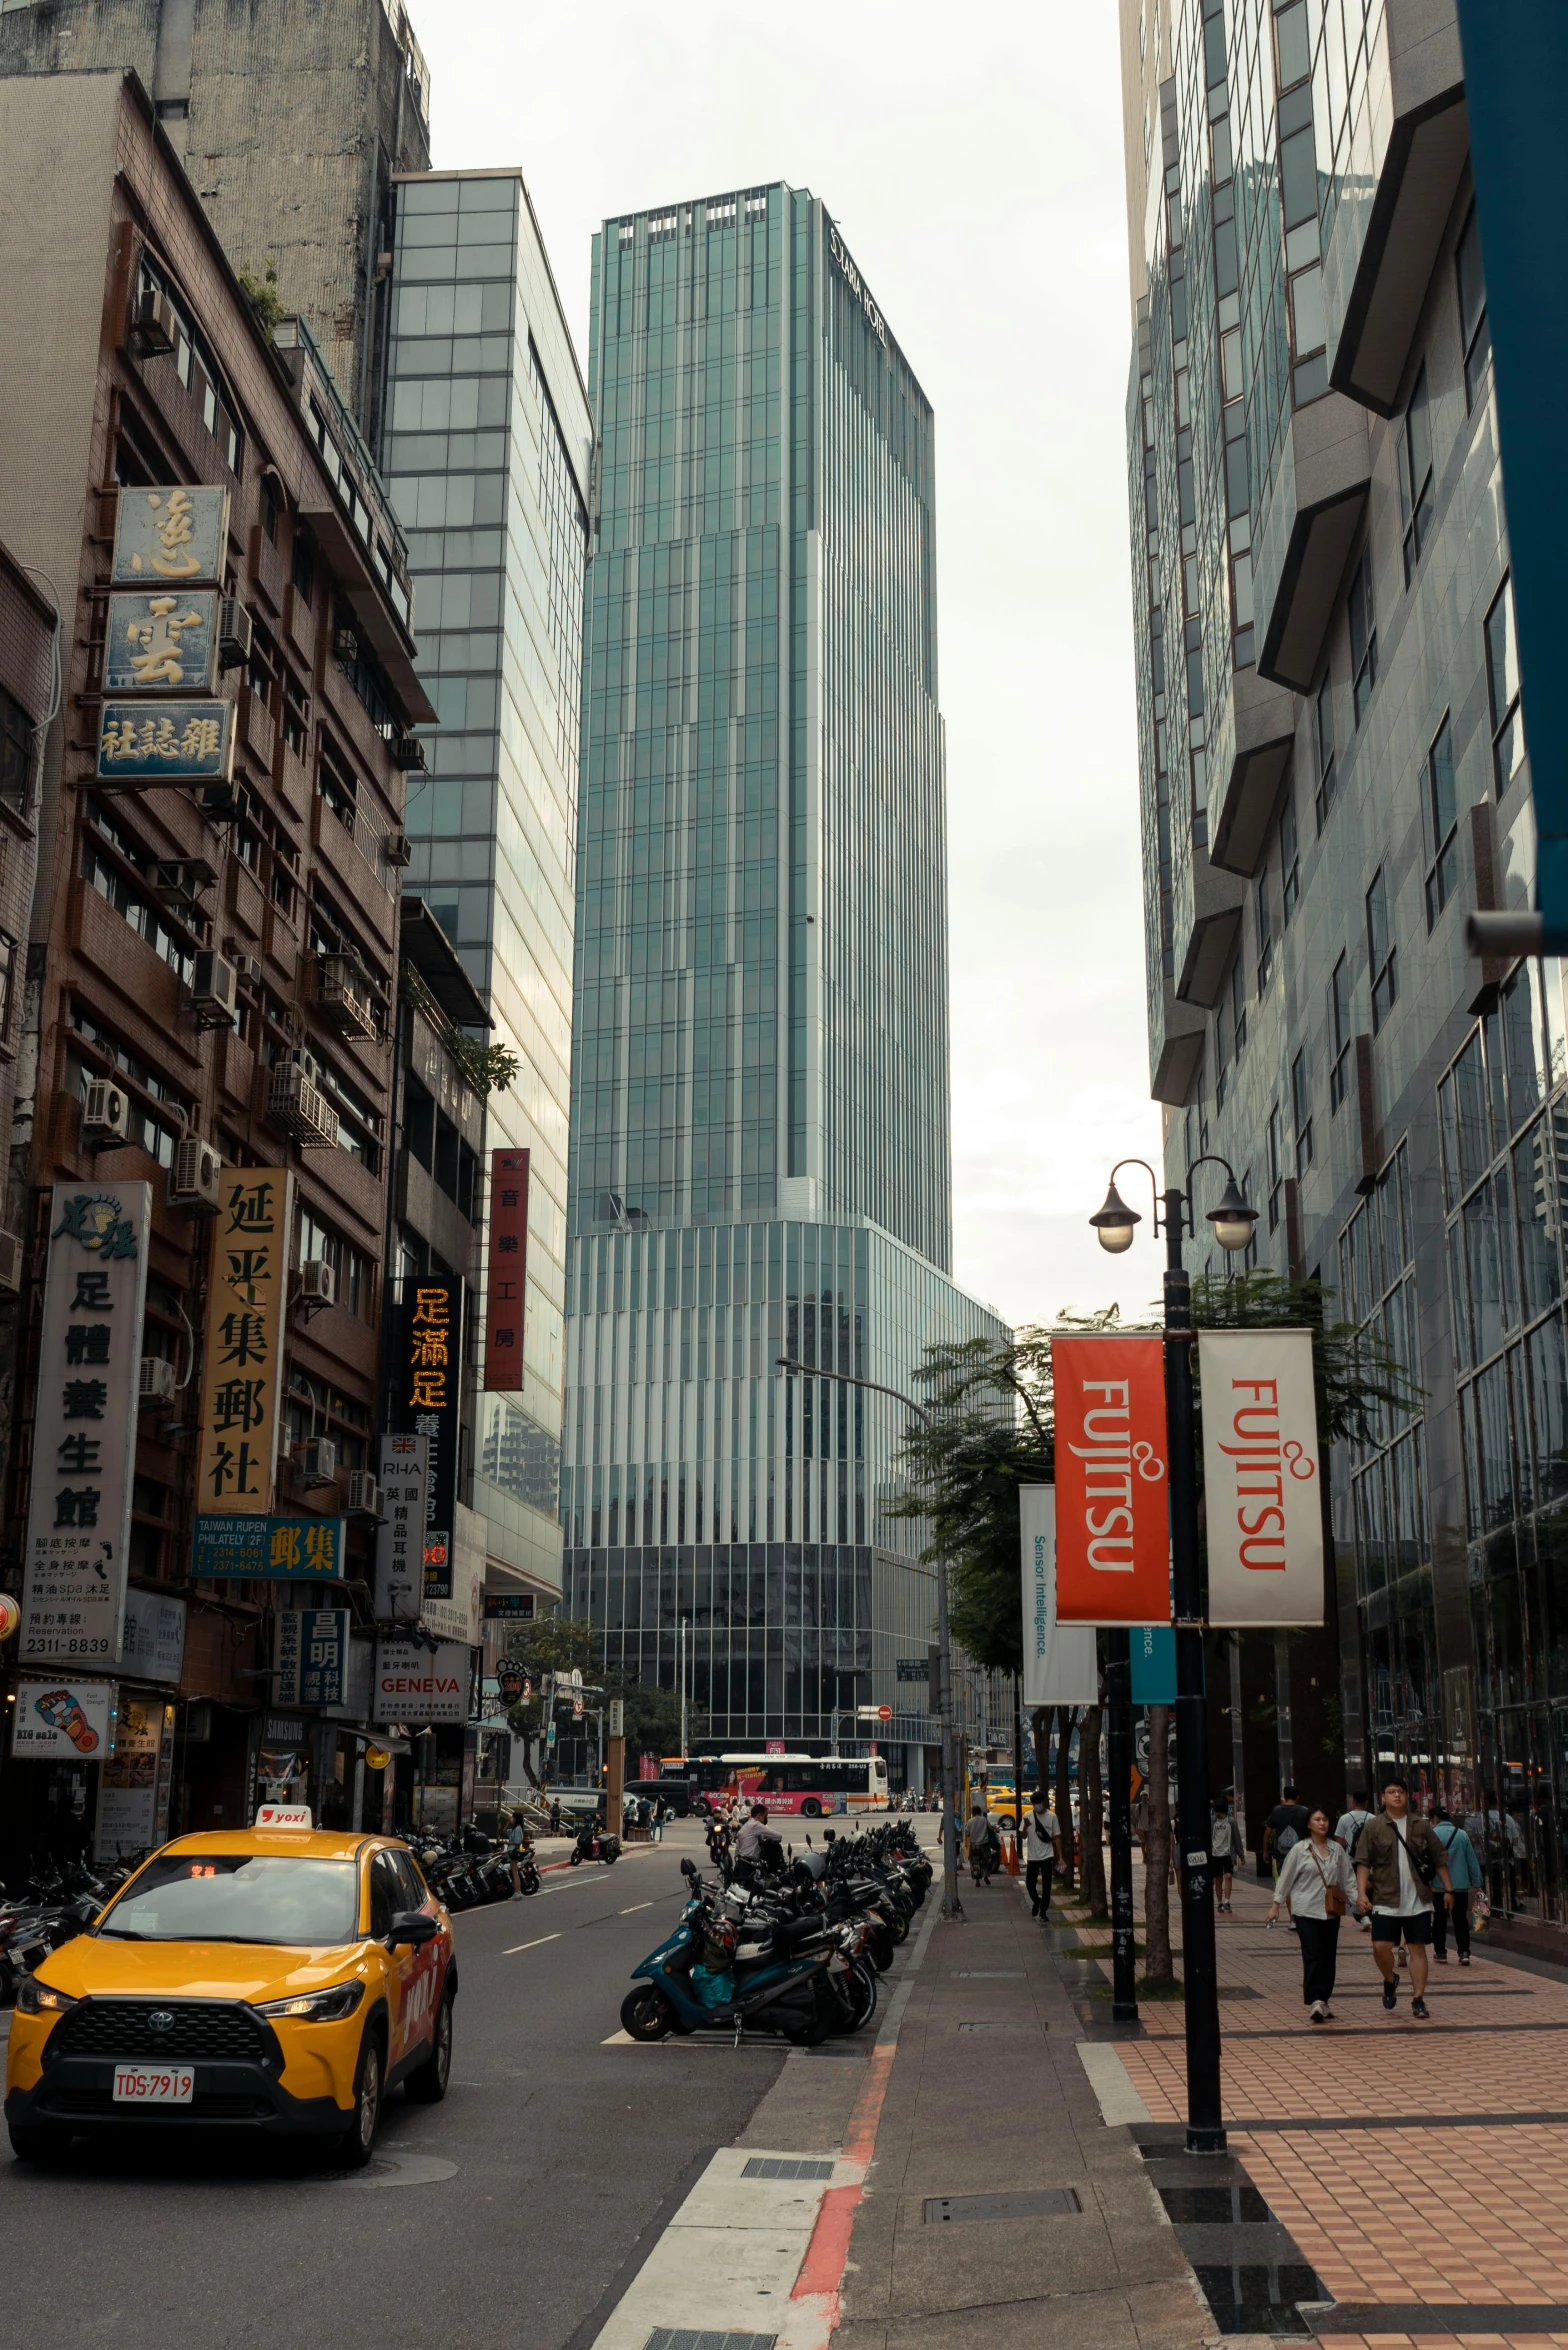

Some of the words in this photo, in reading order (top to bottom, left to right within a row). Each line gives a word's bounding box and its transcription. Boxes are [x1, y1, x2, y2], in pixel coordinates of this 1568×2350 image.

[830, 227, 862, 303] SOLARIA
[863, 288, 887, 349] HOTEL
[494, 1189, 520, 1348] 音樂工房
[208, 1182, 275, 1498] 延平集郵社
[408, 1288, 450, 1408] 足滿足
[53, 1272, 115, 1528] 足體養生館
[383, 1463, 422, 1475] RHA
[1067, 1378, 1135, 1574] FUJITSU
[1217, 1377, 1286, 1572] FUJITSU
[386, 1487, 418, 1501] 英國
[199, 1520, 233, 1532] TAIWAN
[236, 1521, 267, 1532] RUPEN
[198, 1533, 245, 1545] PHILATELY
[247, 1535, 266, 1546] (2F)
[392, 1506, 408, 1573] 精品耳機
[213, 1547, 264, 1558] 2314-6061
[1034, 1535, 1046, 1579] Sensor
[34, 1560, 89, 1571] 全身按摩
[213, 1560, 264, 1572] 2371-6475
[28, 1627, 84, 1635] Reservation
[1034, 1583, 1047, 1658] Intelligence.
[27, 1638, 109, 1653] 2311-8839
[310, 1612, 339, 1668] 昌明
[381, 1678, 460, 1693] GENEVA
[16, 1729, 34, 1740] BIG
[35, 1729, 58, 1740] sale
[267, 1719, 303, 1741] SAMSUNG
[275, 1811, 307, 1824] yoxi
[403, 1943, 439, 2044] yoxi
